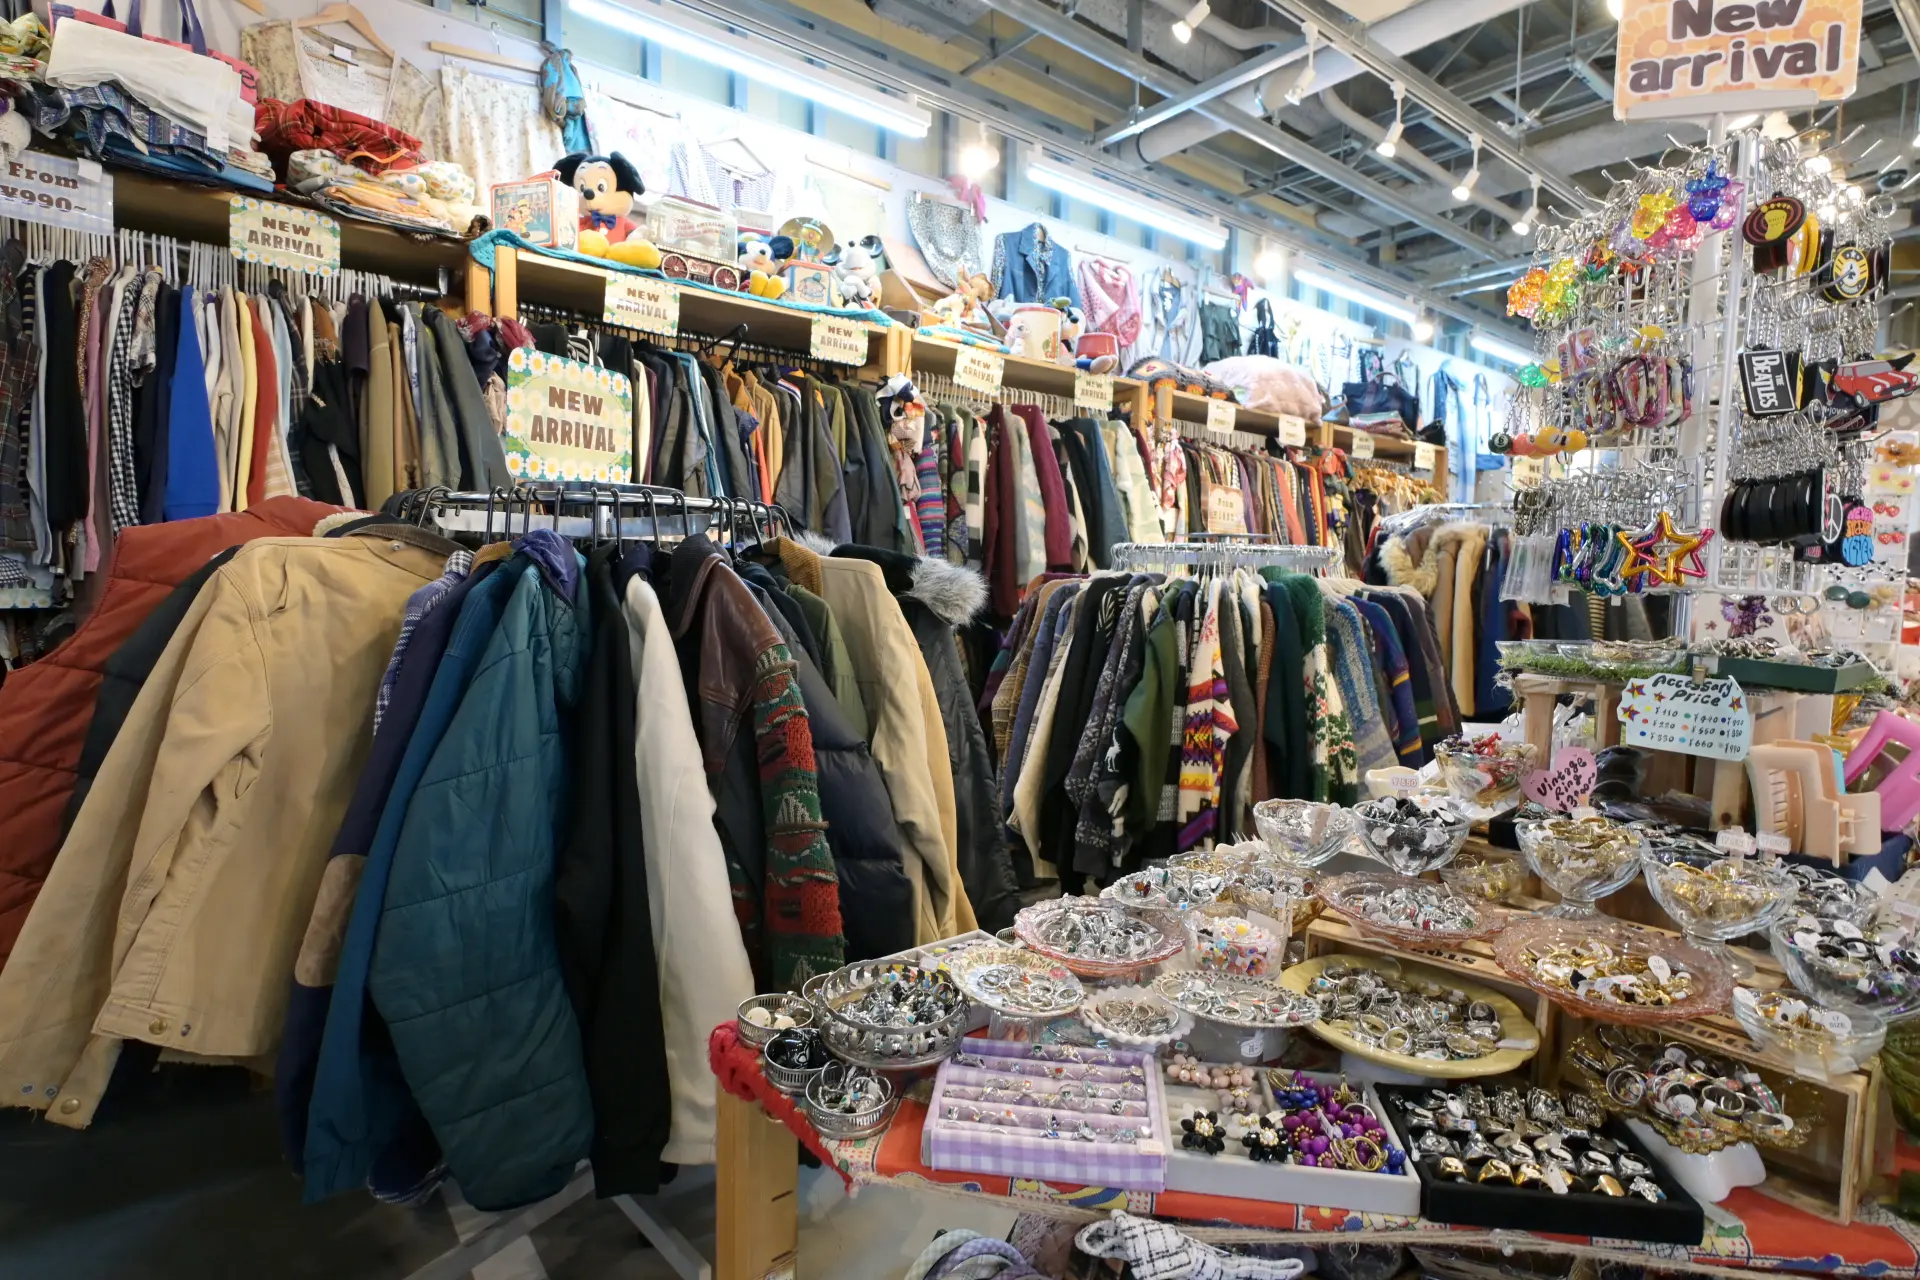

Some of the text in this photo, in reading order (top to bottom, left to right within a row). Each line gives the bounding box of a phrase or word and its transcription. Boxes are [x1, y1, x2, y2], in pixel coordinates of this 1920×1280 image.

[1672, 0, 1801, 41] New
[1629, 24, 1842, 93] arrival
[9, 161, 79, 190] From
[262, 216, 311, 237] NEW
[247, 230, 324, 259] ARRIVAL
[627, 287, 660, 302] NEW
[616, 298, 667, 320] ARRIVAL
[828, 325, 853, 338] NEW
[820, 335, 859, 352] ARRIVAL
[970, 356, 991, 370] NEW
[962, 365, 995, 384] ARRIVAL
[1085, 379, 1103, 389] NEW
[1751, 354, 1780, 409] BEATLES
[1775, 374, 1784, 387] THE
[549, 386, 603, 416] NEW
[1080, 388, 1107, 401] ARRIVAL
[530, 414, 616, 453] ARRIVAL
[1670, 689, 1721, 706] Price
[1537, 757, 1587, 796] Vintage
[1555, 774, 1582, 800] Ring
